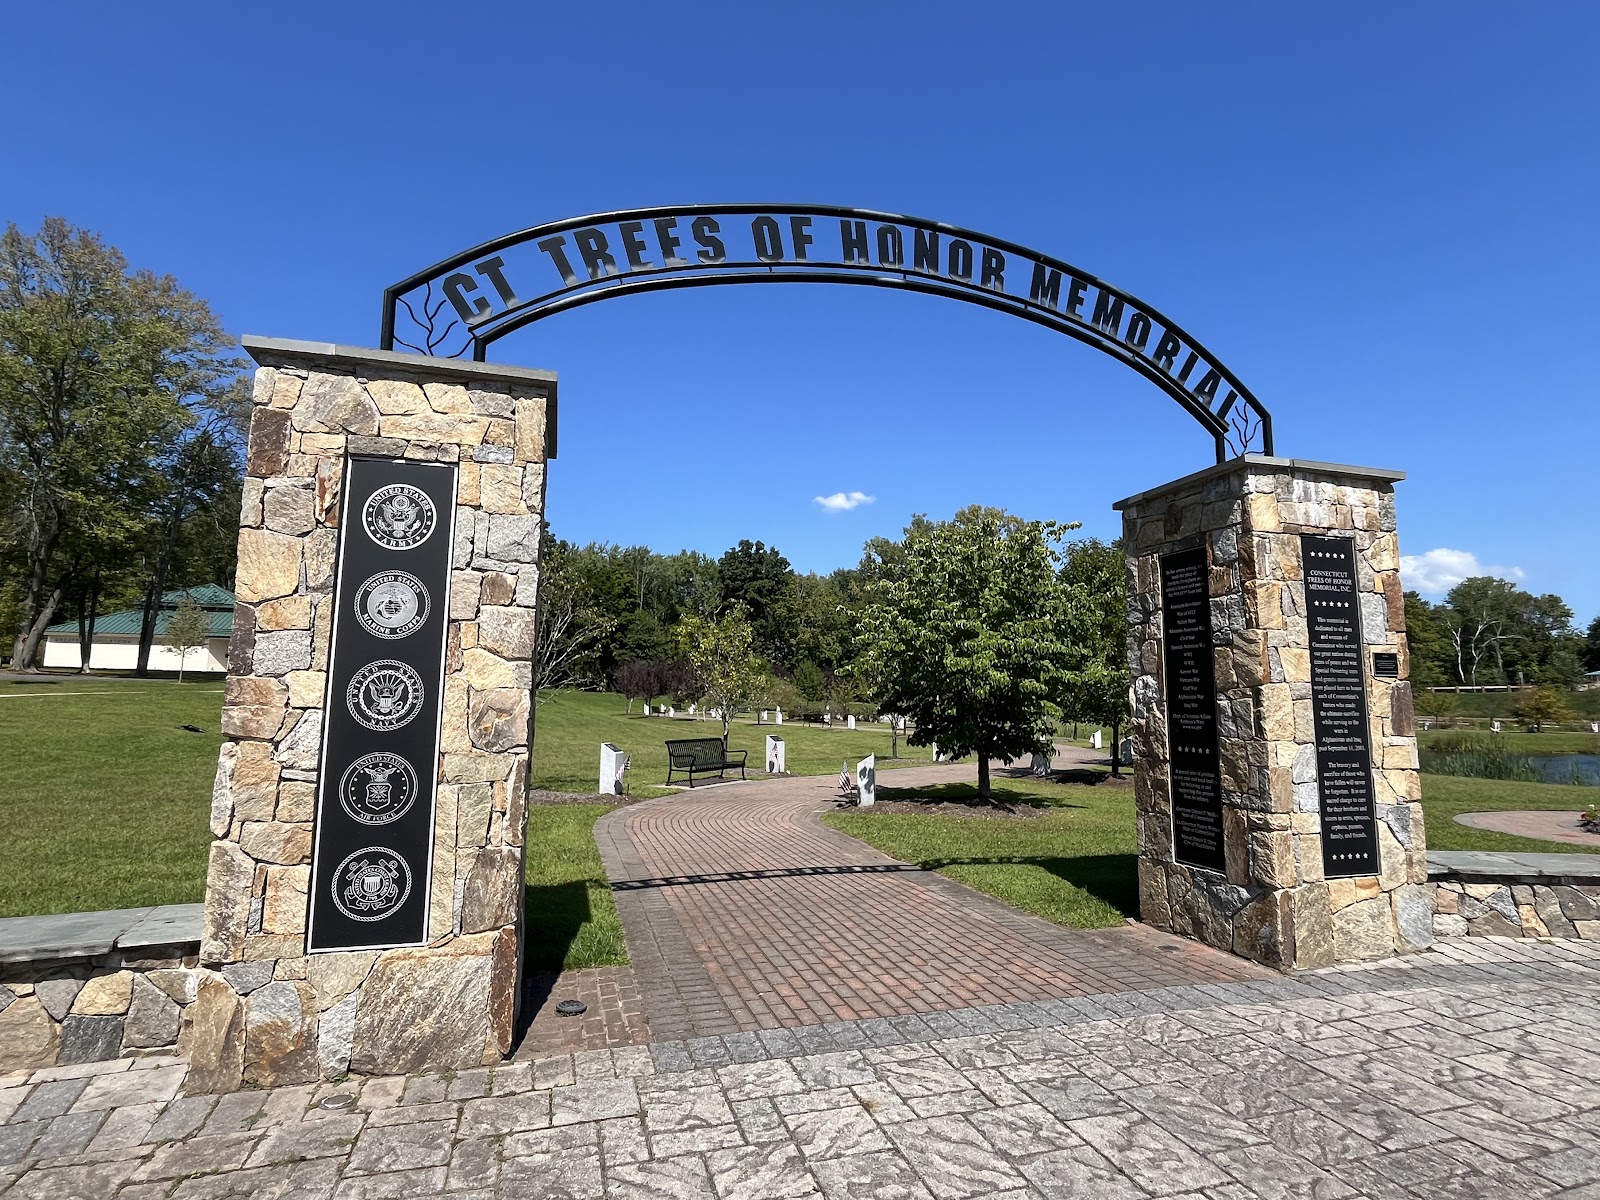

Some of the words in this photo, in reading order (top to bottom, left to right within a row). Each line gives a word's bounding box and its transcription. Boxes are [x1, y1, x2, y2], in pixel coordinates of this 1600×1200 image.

[442, 256, 518, 325] CT
[538, 216, 726, 287] TREES
[751, 216, 813, 262] OF
[840, 219, 1005, 291] HONOR
[1029, 260, 1239, 425] MEMORIAL
[370, 487, 401, 506] UNITED
[404, 488, 431, 510] STATES
[381, 538, 415, 548] ARMY
[366, 576, 394, 592] UNITED
[397, 576, 421, 594] STATES
[362, 612, 391, 634] MARINE
[396, 616, 421, 634] CORPS
[352, 666, 378, 702] UNITED
[400, 668, 418, 704] STATES
[370, 718, 396, 726] NAVY
[356, 756, 382, 769] UNITED
[384, 756, 406, 769] STATES
[358, 812, 371, 821] AIR
[373, 812, 397, 822] FORCE
